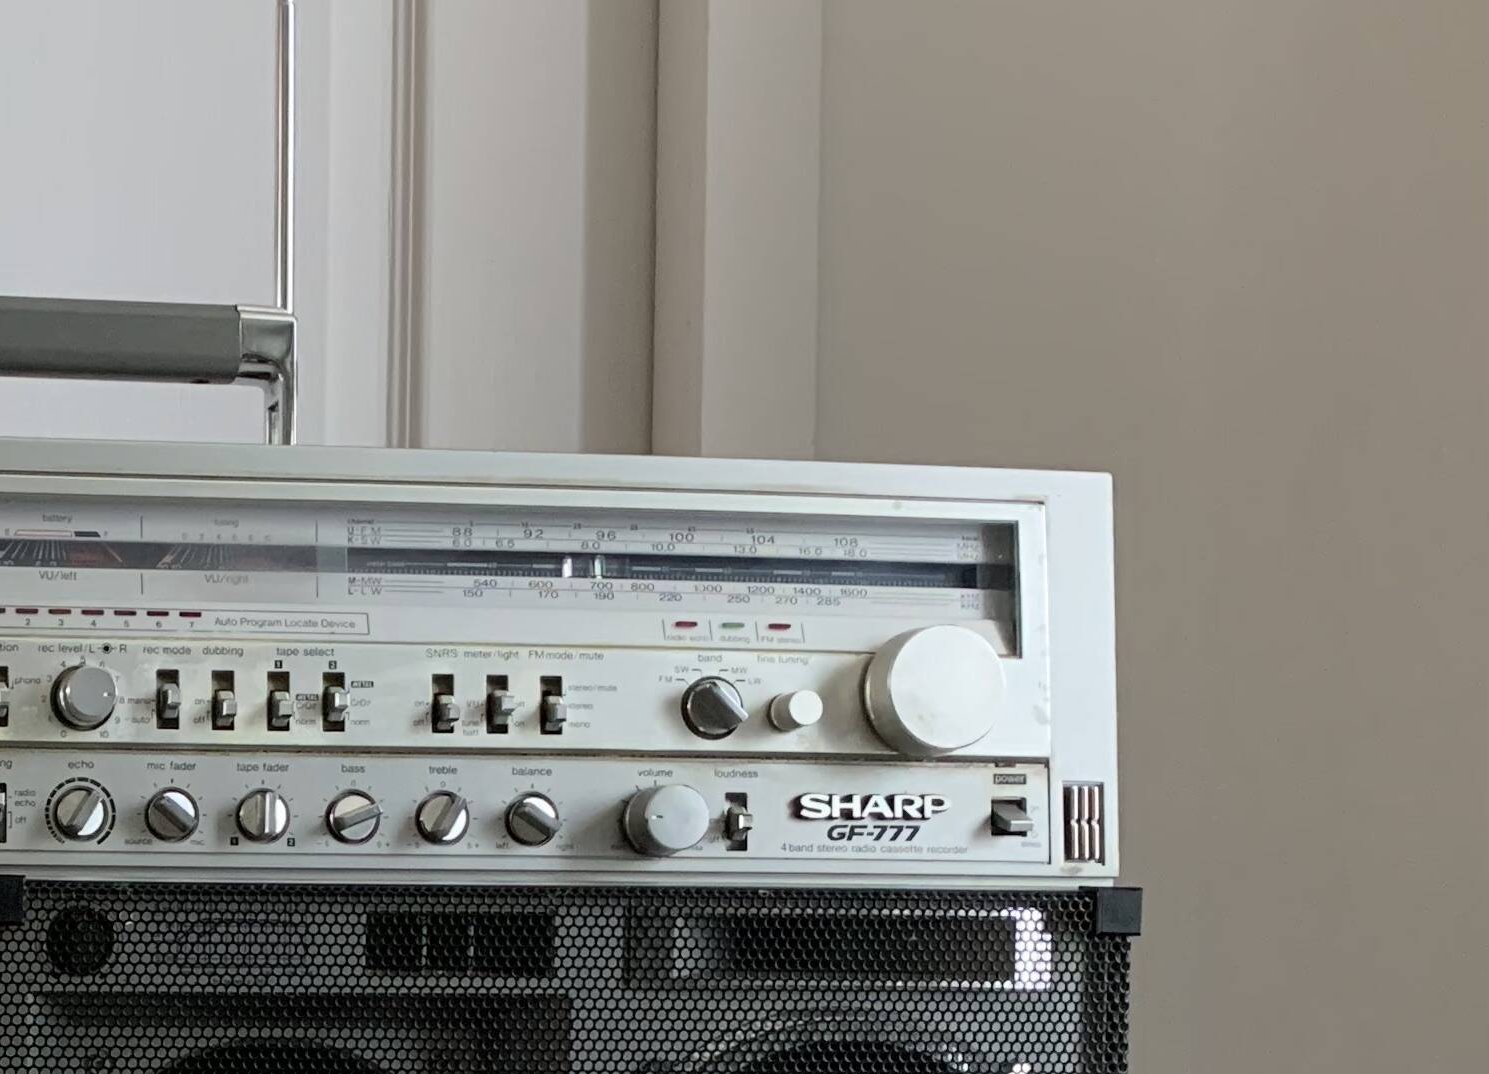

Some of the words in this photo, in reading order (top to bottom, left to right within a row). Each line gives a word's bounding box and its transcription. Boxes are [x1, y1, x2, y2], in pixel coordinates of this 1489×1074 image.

[42, 514, 73, 523] battery
[452, 527, 473, 537] 88
[523, 529, 544, 538] 92
[596, 530, 616, 541] 96
[670, 532, 694, 543] 100
[751, 535, 775, 545] 104
[833, 537, 858, 548] 108
[473, 578, 498, 588] 540
[528, 580, 553, 589] 600
[590, 581, 613, 590] 700
[630, 583, 655, 592] 800
[747, 586, 775, 594] 1200
[792, 587, 822, 596] 1400
[840, 588, 868, 598] 1600
[463, 589, 484, 598] 150
[538, 590, 559, 599] 170
[594, 592, 615, 600] 190
[659, 592, 682, 602] 220
[727, 594, 751, 604] 250
[775, 596, 798, 605] 270
[816, 597, 841, 606] 285
[24, 618, 31, 626] 2
[90, 619, 97, 627] 4
[214, 617, 238, 627] Auto
[240, 617, 282, 629] Program
[284, 618, 318, 628] Locate
[321, 619, 356, 629] Device
[38, 644, 55, 653] rec
[119, 644, 128, 653] R
[142, 645, 159, 655] rec
[162, 645, 192, 655] mode
[202, 646, 244, 657] dubbing
[276, 647, 300, 657] tape
[303, 647, 335, 657] select
[425, 648, 459, 659] SNRS
[697, 654, 723, 663] band
[778, 655, 809, 666] tuning
[14, 676, 41, 686] phono
[67, 760, 95, 769] echo
[147, 761, 165, 770] mic
[169, 761, 197, 771] fader
[236, 762, 259, 773] tape
[262, 762, 289, 772] fader
[341, 763, 366, 774] bass
[429, 765, 458, 775] treble
[511, 766, 553, 777] balance
[638, 768, 673, 777] volume
[714, 768, 759, 778] loudness
[994, 775, 1026, 785] power
[14, 789, 37, 797] radio
[14, 799, 37, 807] echo
[798, 792, 952, 820] SHARP
[826, 824, 921, 842] GF-777
[780, 844, 788, 852] 4
[788, 843, 814, 853] band
[816, 844, 848, 853] stereo
[850, 844, 877, 853] radio
[879, 844, 924, 854] cassette
[926, 845, 969, 855] recorder
